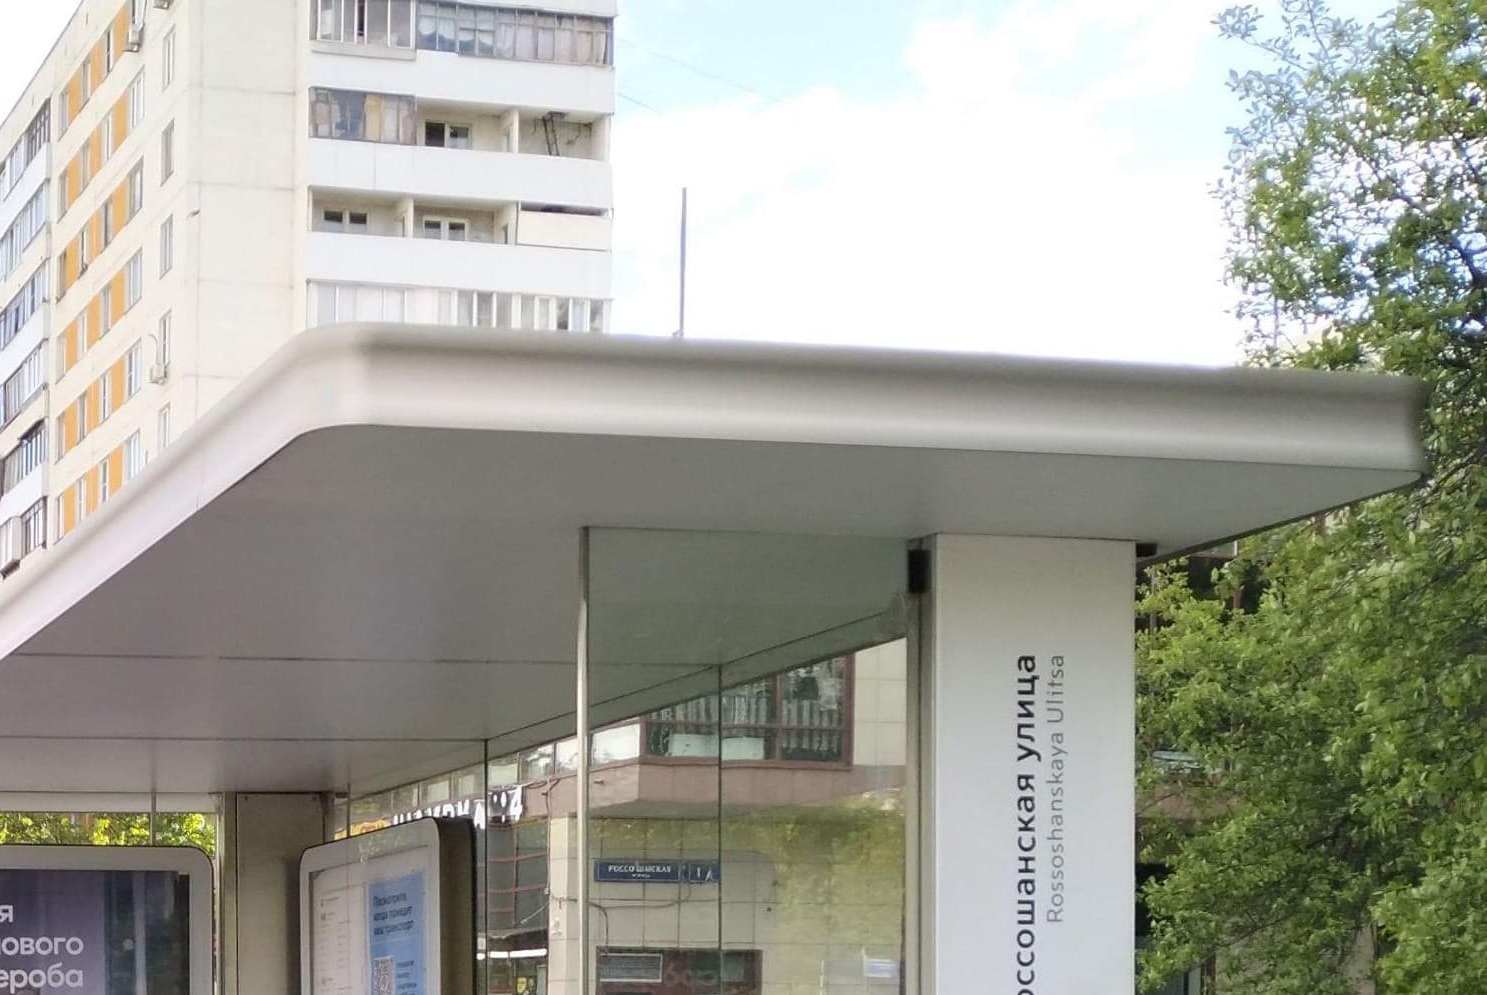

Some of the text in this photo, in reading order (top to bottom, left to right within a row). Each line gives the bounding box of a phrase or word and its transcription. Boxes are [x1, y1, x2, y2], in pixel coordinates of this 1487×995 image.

[1017, 655, 1041, 762] улица
[1047, 654, 1068, 923] Rossoshanskaya Ulitsa
